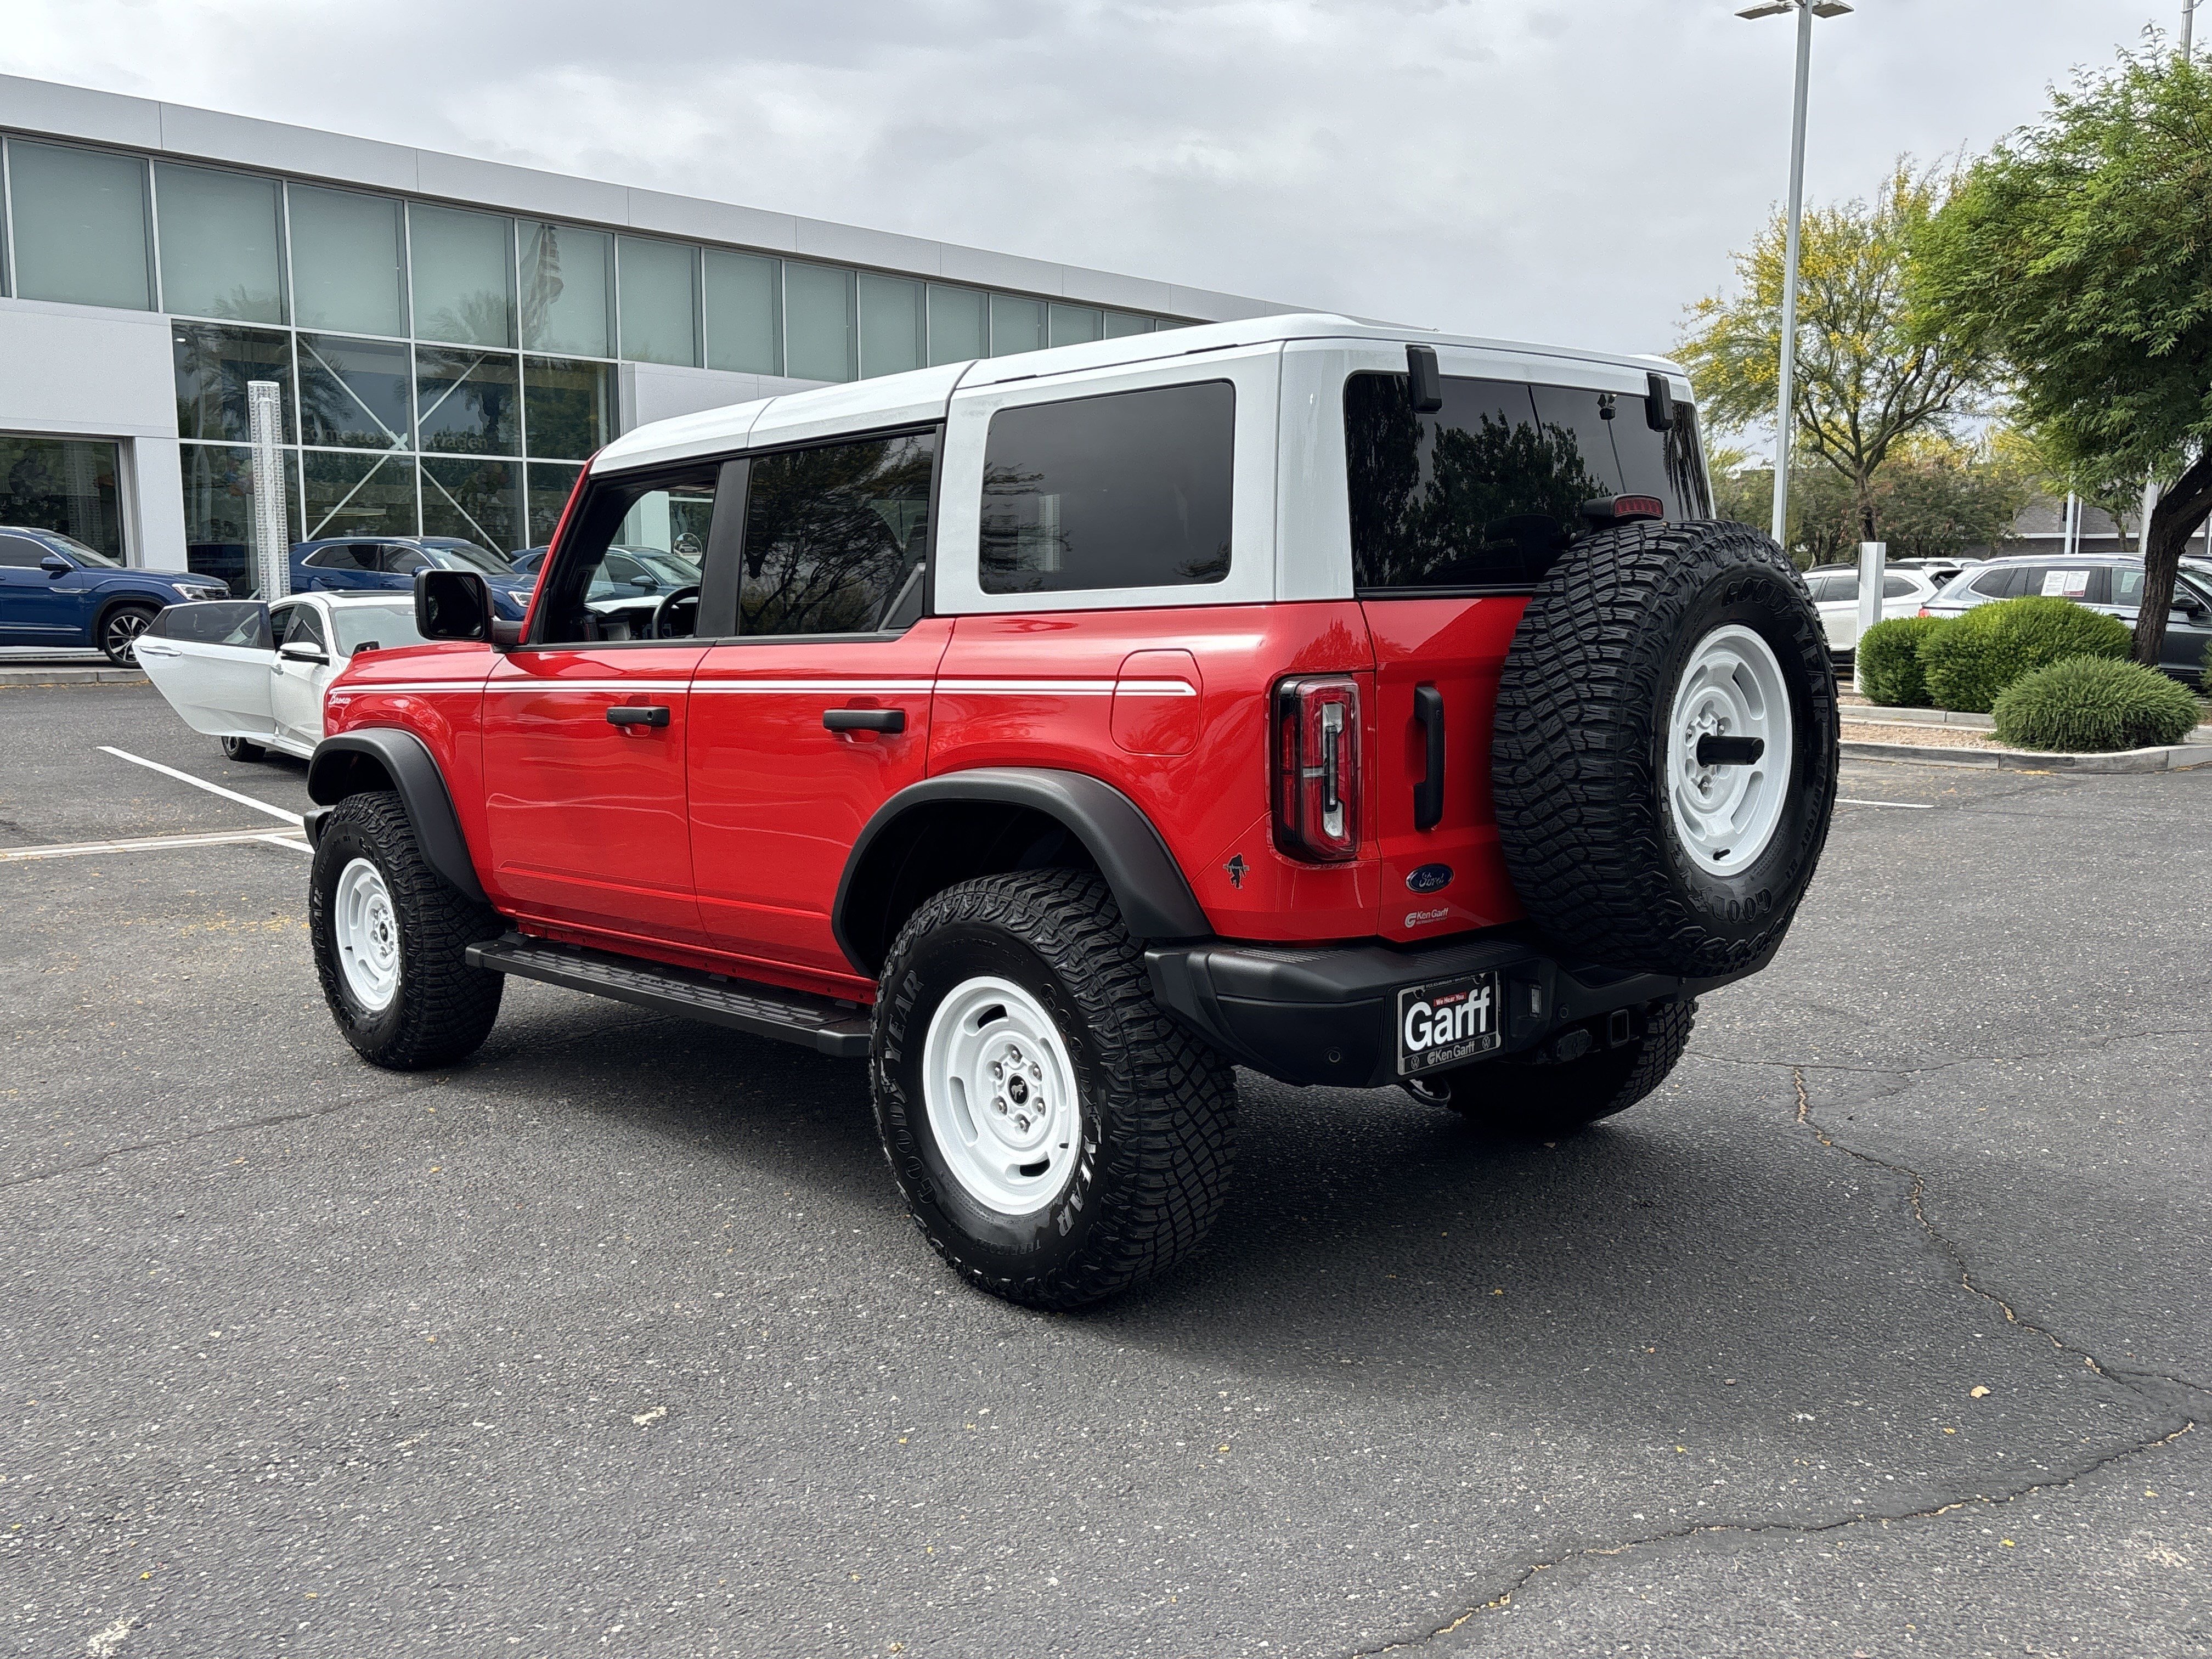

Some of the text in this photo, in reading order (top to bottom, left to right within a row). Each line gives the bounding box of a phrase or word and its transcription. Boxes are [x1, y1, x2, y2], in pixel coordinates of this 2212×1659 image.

[1419, 872, 1444, 887] Ford
[1417, 911, 1430, 920] Ken
[1431, 907, 1449, 918] Garff
[1444, 996, 1455, 1004] Hear
[1405, 986, 1490, 1051] Garff
[1435, 1048, 1453, 1063] Ken
[1453, 1040, 1475, 1057] Garff
[880, 969, 936, 1204] GOODYEAR
[1041, 983, 1103, 1237] GOODYEAR
